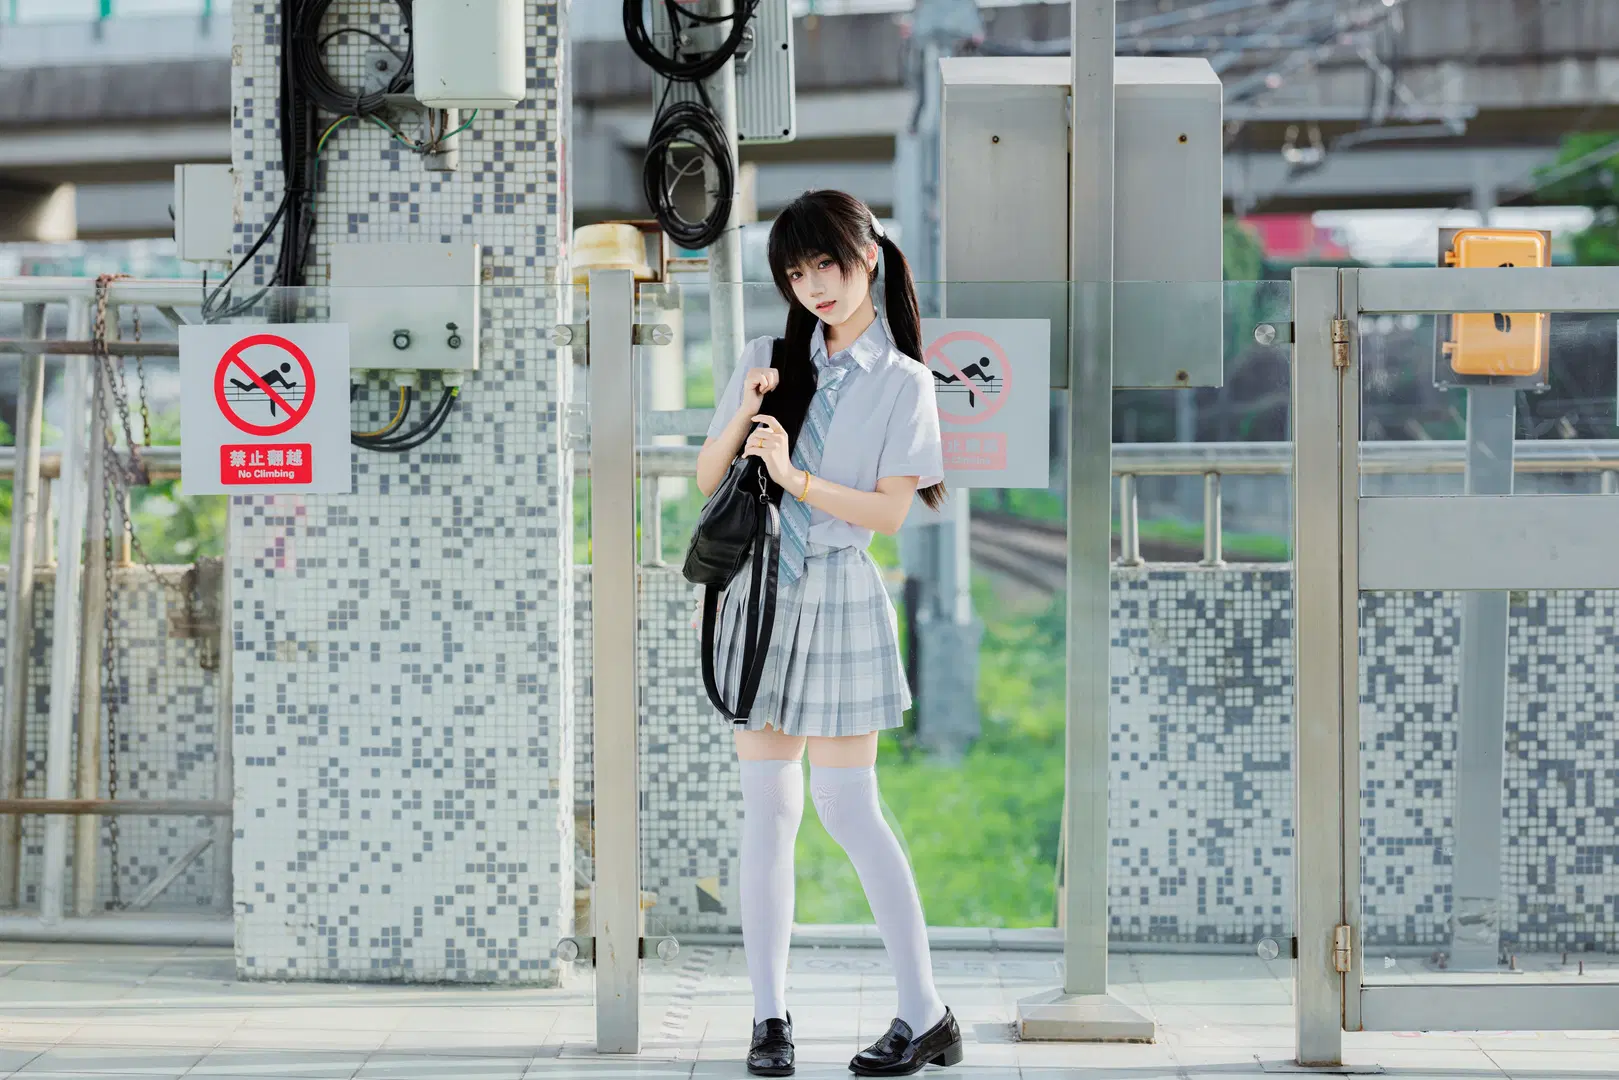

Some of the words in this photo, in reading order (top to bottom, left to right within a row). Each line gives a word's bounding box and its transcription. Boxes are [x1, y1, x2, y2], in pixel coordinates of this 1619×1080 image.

[229, 449, 303, 467] 禁止翻越
[238, 470, 252, 478] No
[254, 469, 295, 480] Climbing
